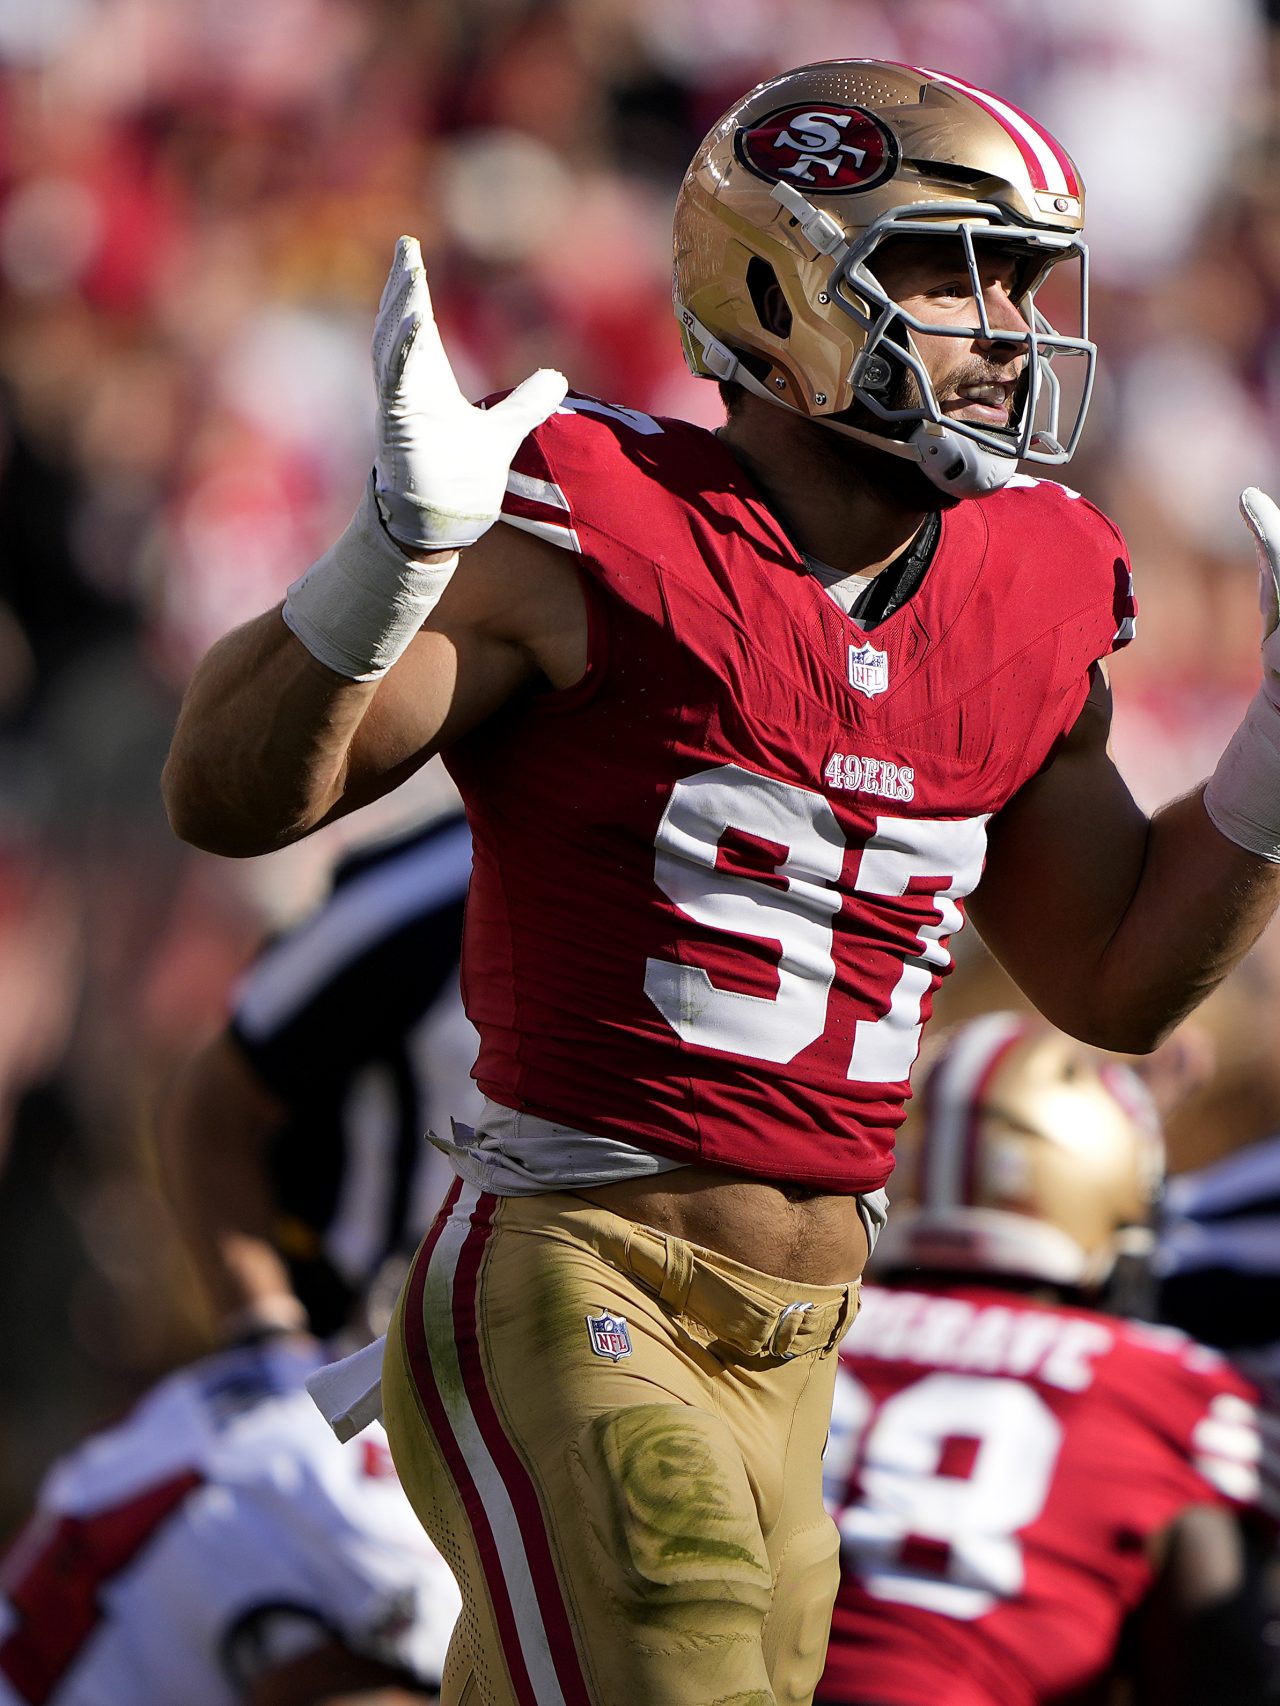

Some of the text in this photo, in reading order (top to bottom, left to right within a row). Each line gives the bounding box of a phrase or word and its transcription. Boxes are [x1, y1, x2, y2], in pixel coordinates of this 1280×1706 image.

[682, 311, 694, 329] 97
[855, 665, 882, 687] NFL
[824, 752, 915, 802] 49ERS
[643, 763, 993, 1082] 97
[597, 1333, 627, 1353] NFL
